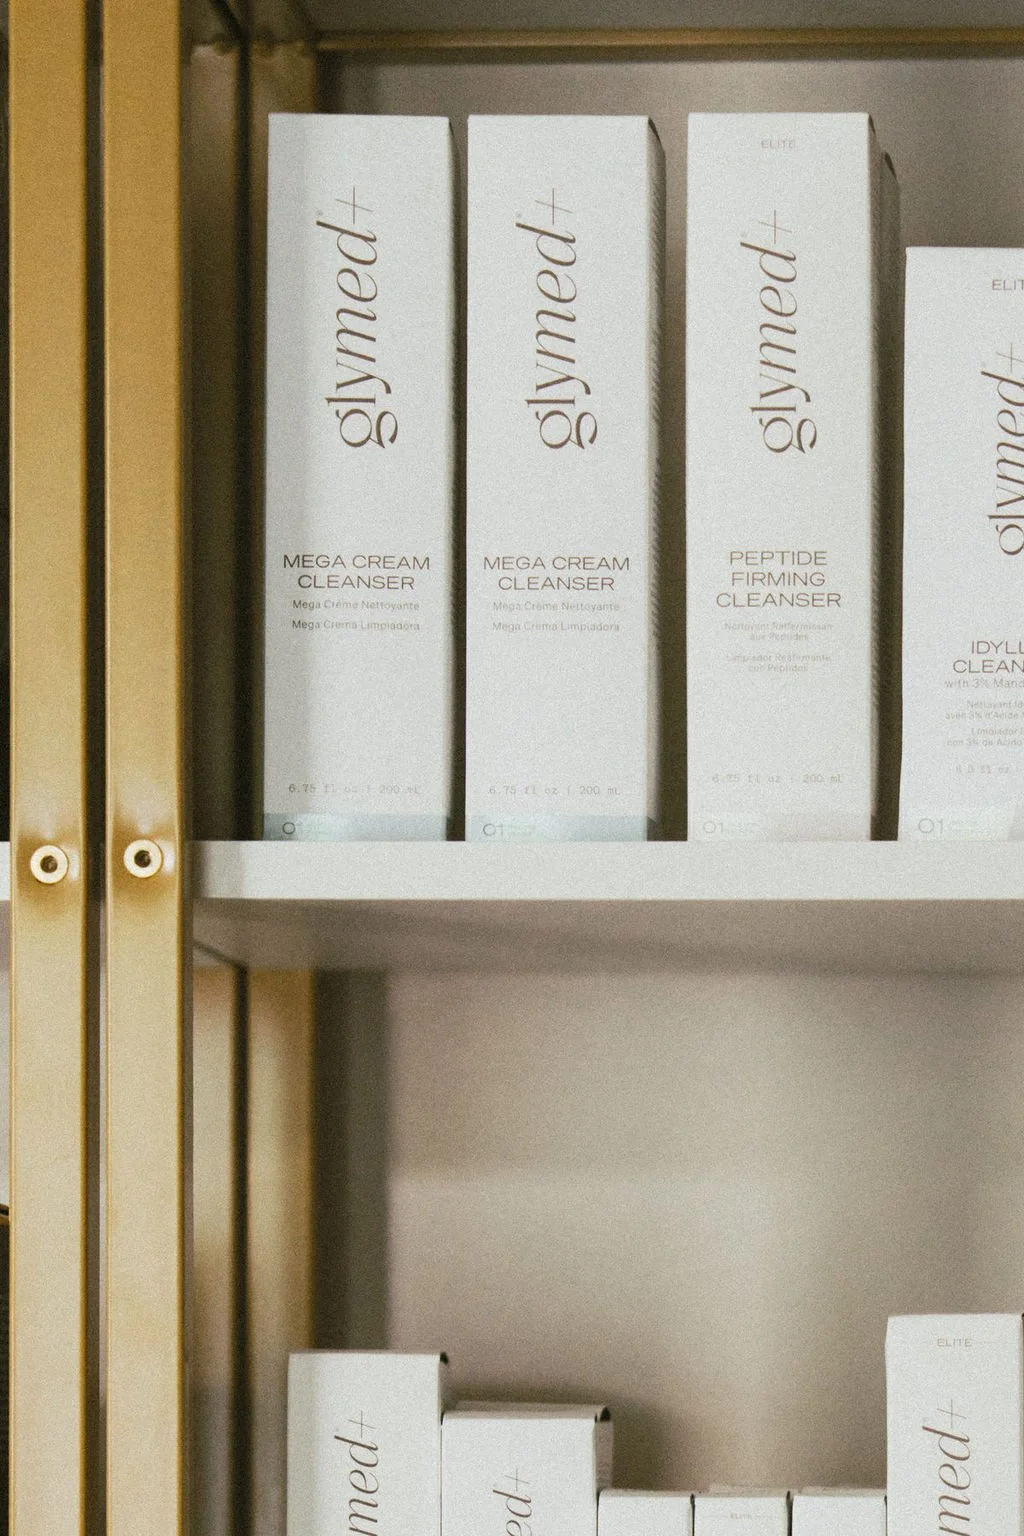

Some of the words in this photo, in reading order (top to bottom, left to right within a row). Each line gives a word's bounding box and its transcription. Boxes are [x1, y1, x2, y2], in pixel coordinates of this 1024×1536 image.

[283, 554, 346, 570] MEGA
[352, 555, 430, 571] CREAM
[482, 557, 546, 571] MEGA
[551, 557, 631, 571] CREAM
[729, 551, 827, 566] PEPTIDE
[297, 575, 415, 590] CLEANSER
[498, 576, 615, 591] CLEANSER
[731, 571, 826, 587] FIRMING
[716, 592, 841, 608] CLEANSER
[917, 818, 944, 835] 01
